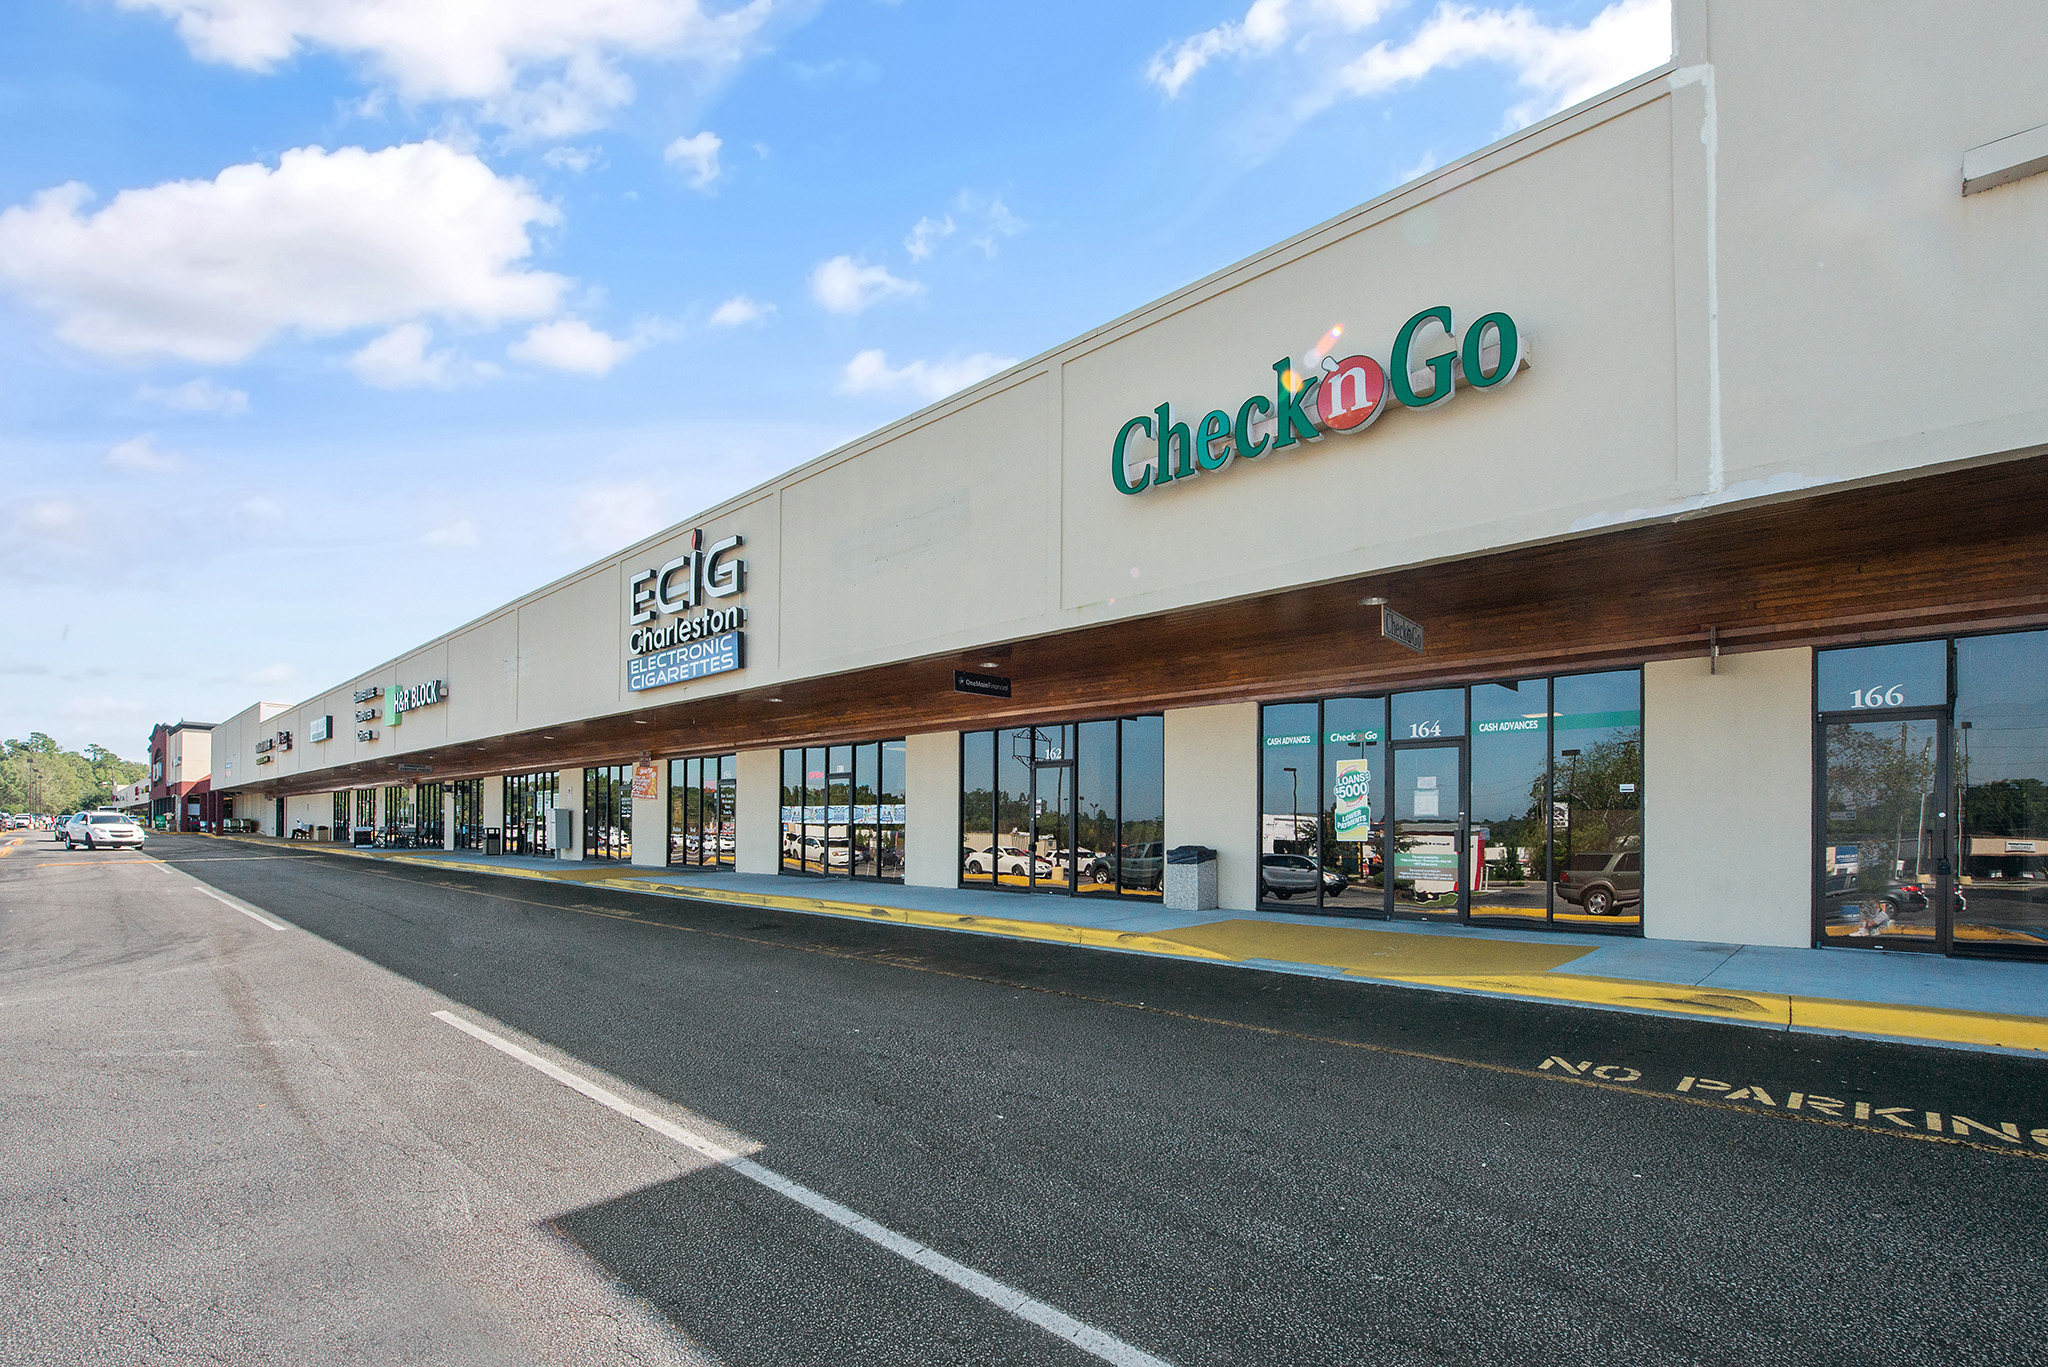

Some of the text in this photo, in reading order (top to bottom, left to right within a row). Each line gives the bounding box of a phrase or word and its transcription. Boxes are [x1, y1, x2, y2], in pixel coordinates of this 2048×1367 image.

[1112, 356, 1321, 496] Check
[1390, 305, 1519, 408] Go
[629, 606, 738, 655] Charleston
[630, 634, 733, 675] ELECTRONIC
[631, 653, 734, 690] CIGARETTES
[393, 680, 439, 713] H&R BLOCK
[1849, 684, 1904, 708] 166
[1410, 720, 1442, 738] 164
[1478, 720, 1539, 732] CASH ADVANCES
[1267, 735, 1311, 746] CASH ADVANCES
[1330, 733, 1356, 742] Check
[1365, 731, 1378, 740] Go
[1045, 747, 1062, 760] 162
[808, 771, 824, 779] OPEN
[1338, 773, 1366, 786] LOANS
[1336, 782, 1367, 799] $5000
[1337, 814, 1367, 830] PAYMENTS
[1342, 809, 1362, 823] LOWER
[1538, 1056, 1642, 1082] NO
